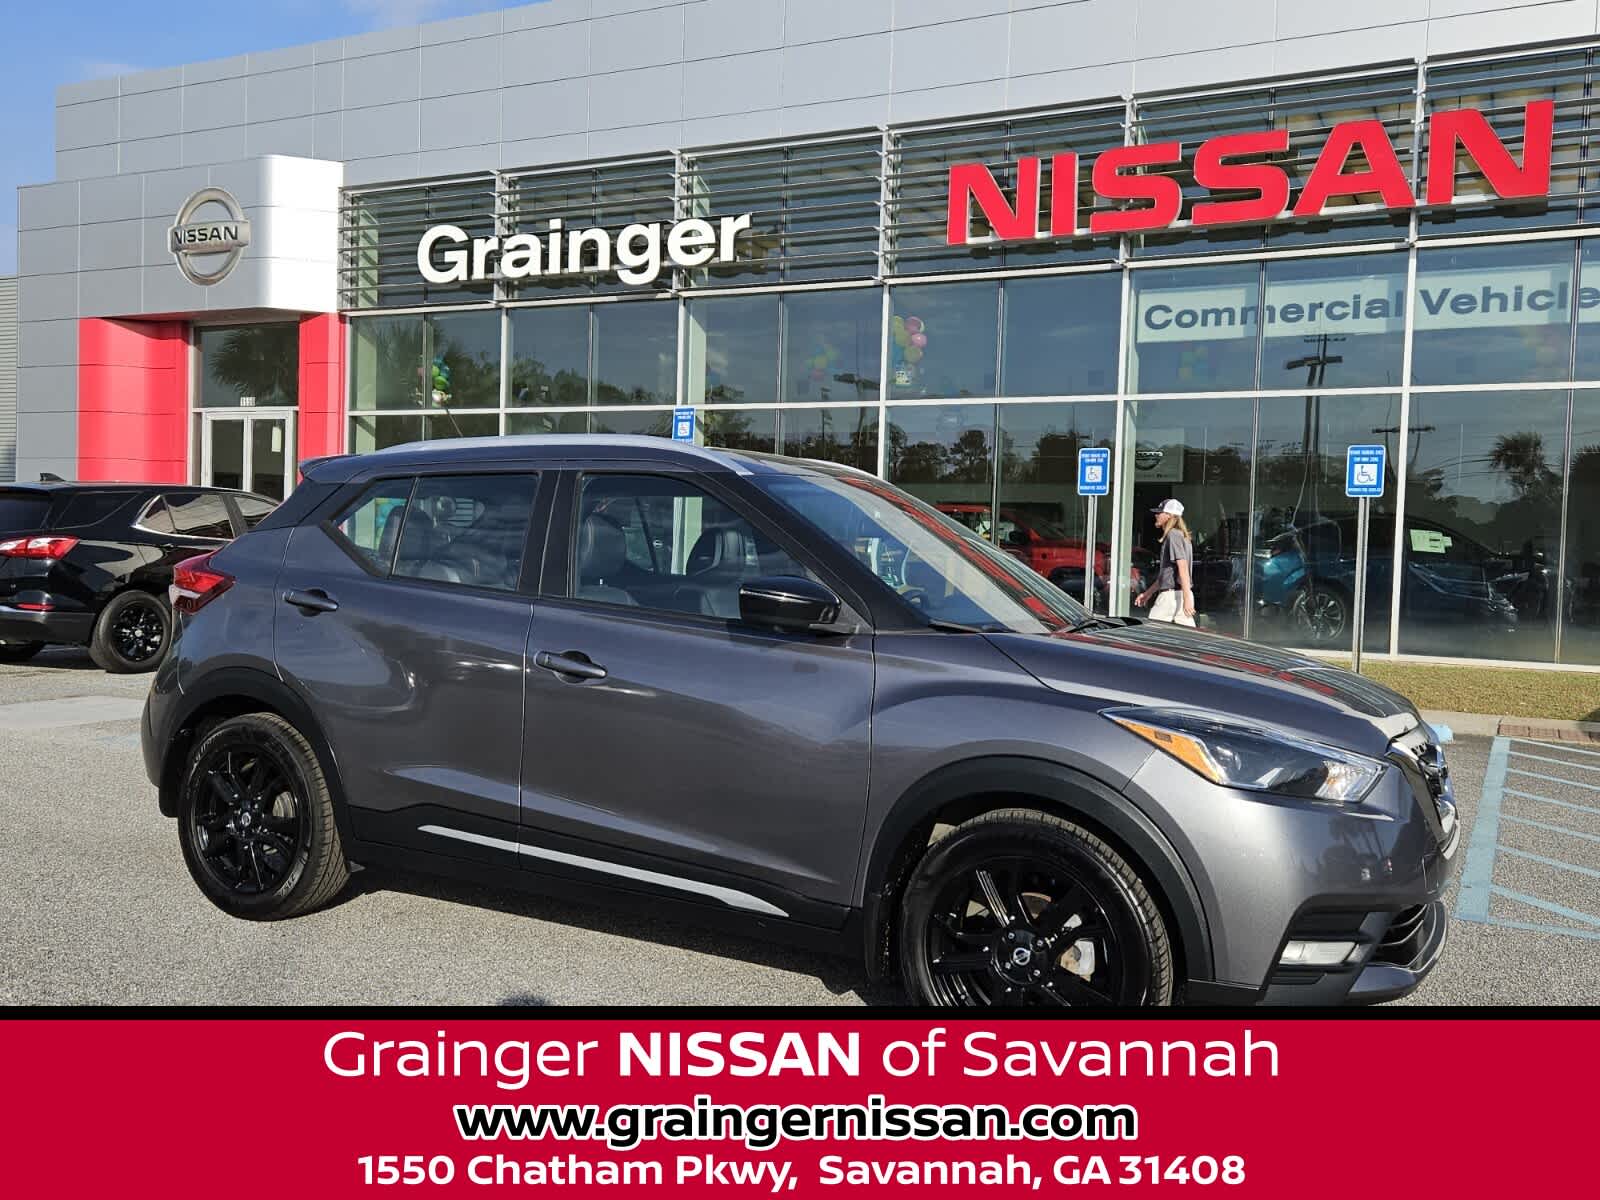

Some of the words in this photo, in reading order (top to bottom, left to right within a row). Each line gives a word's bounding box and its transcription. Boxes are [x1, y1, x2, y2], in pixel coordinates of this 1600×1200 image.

[946, 99, 1554, 247] NISSAN
[173, 225, 239, 245] NISSAN
[417, 213, 752, 286] Grainger
[1144, 289, 1404, 330] Commercial
[1419, 281, 1600, 316] Vehicle
